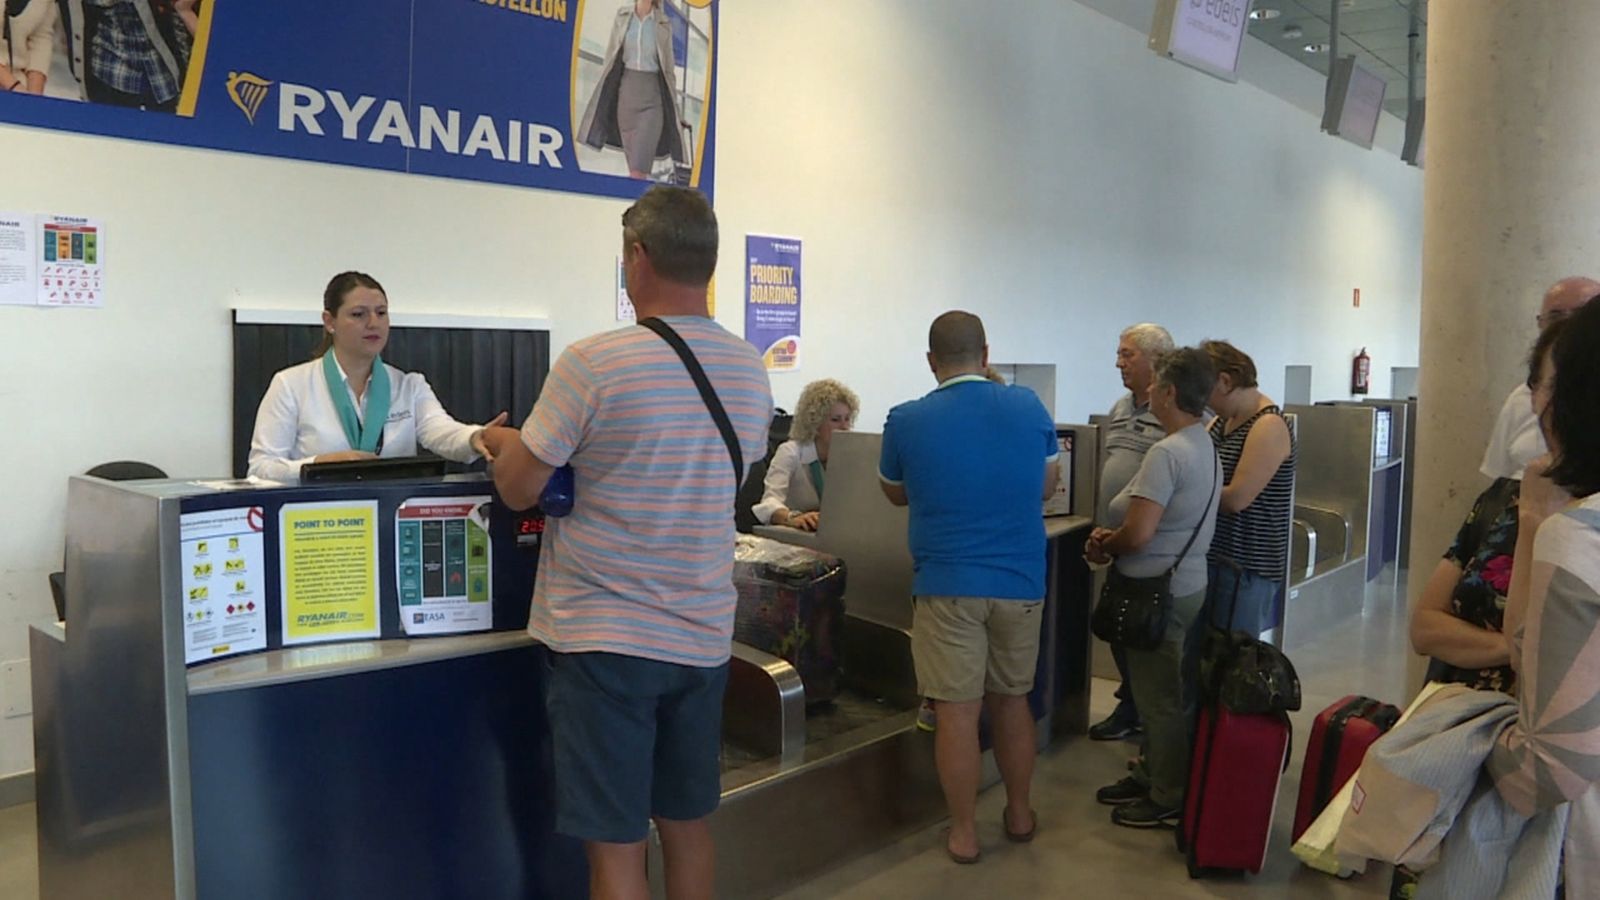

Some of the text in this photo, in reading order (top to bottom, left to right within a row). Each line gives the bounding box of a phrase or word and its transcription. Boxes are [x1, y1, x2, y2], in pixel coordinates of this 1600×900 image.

[277, 82, 564, 169] RYANAIR
[750, 264, 794, 286] PRIORITY
[750, 284, 798, 305] BOARDING
[294, 518, 365, 529] POINT TO POINT
[424, 612, 445, 621] EASA
